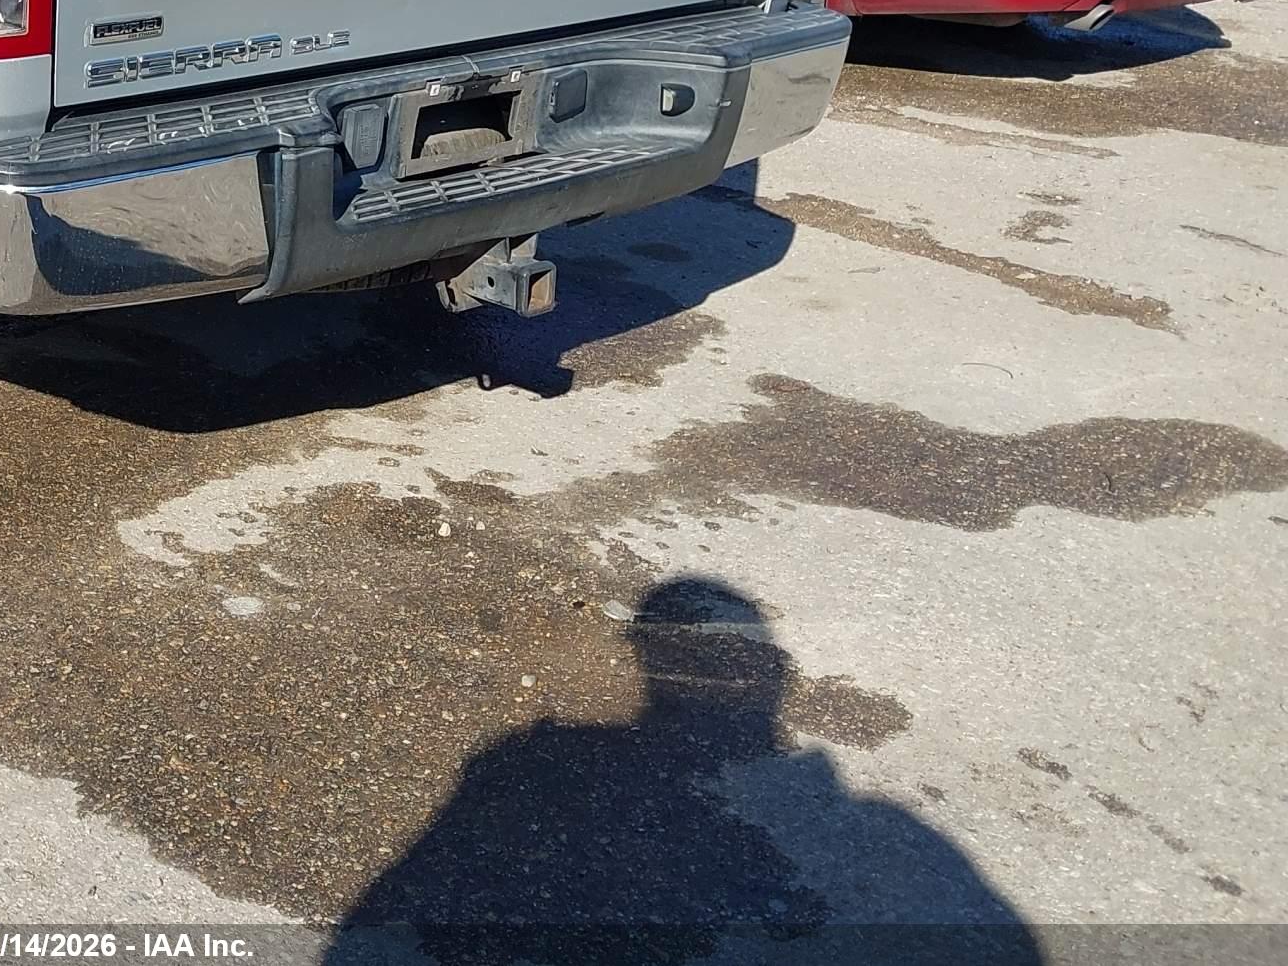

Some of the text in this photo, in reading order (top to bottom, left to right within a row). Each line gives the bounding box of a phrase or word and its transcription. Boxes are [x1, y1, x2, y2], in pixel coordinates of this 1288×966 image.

[95, 17, 161, 38] FLEXFUEL
[86, 29, 352, 89] SIERRA SLE
